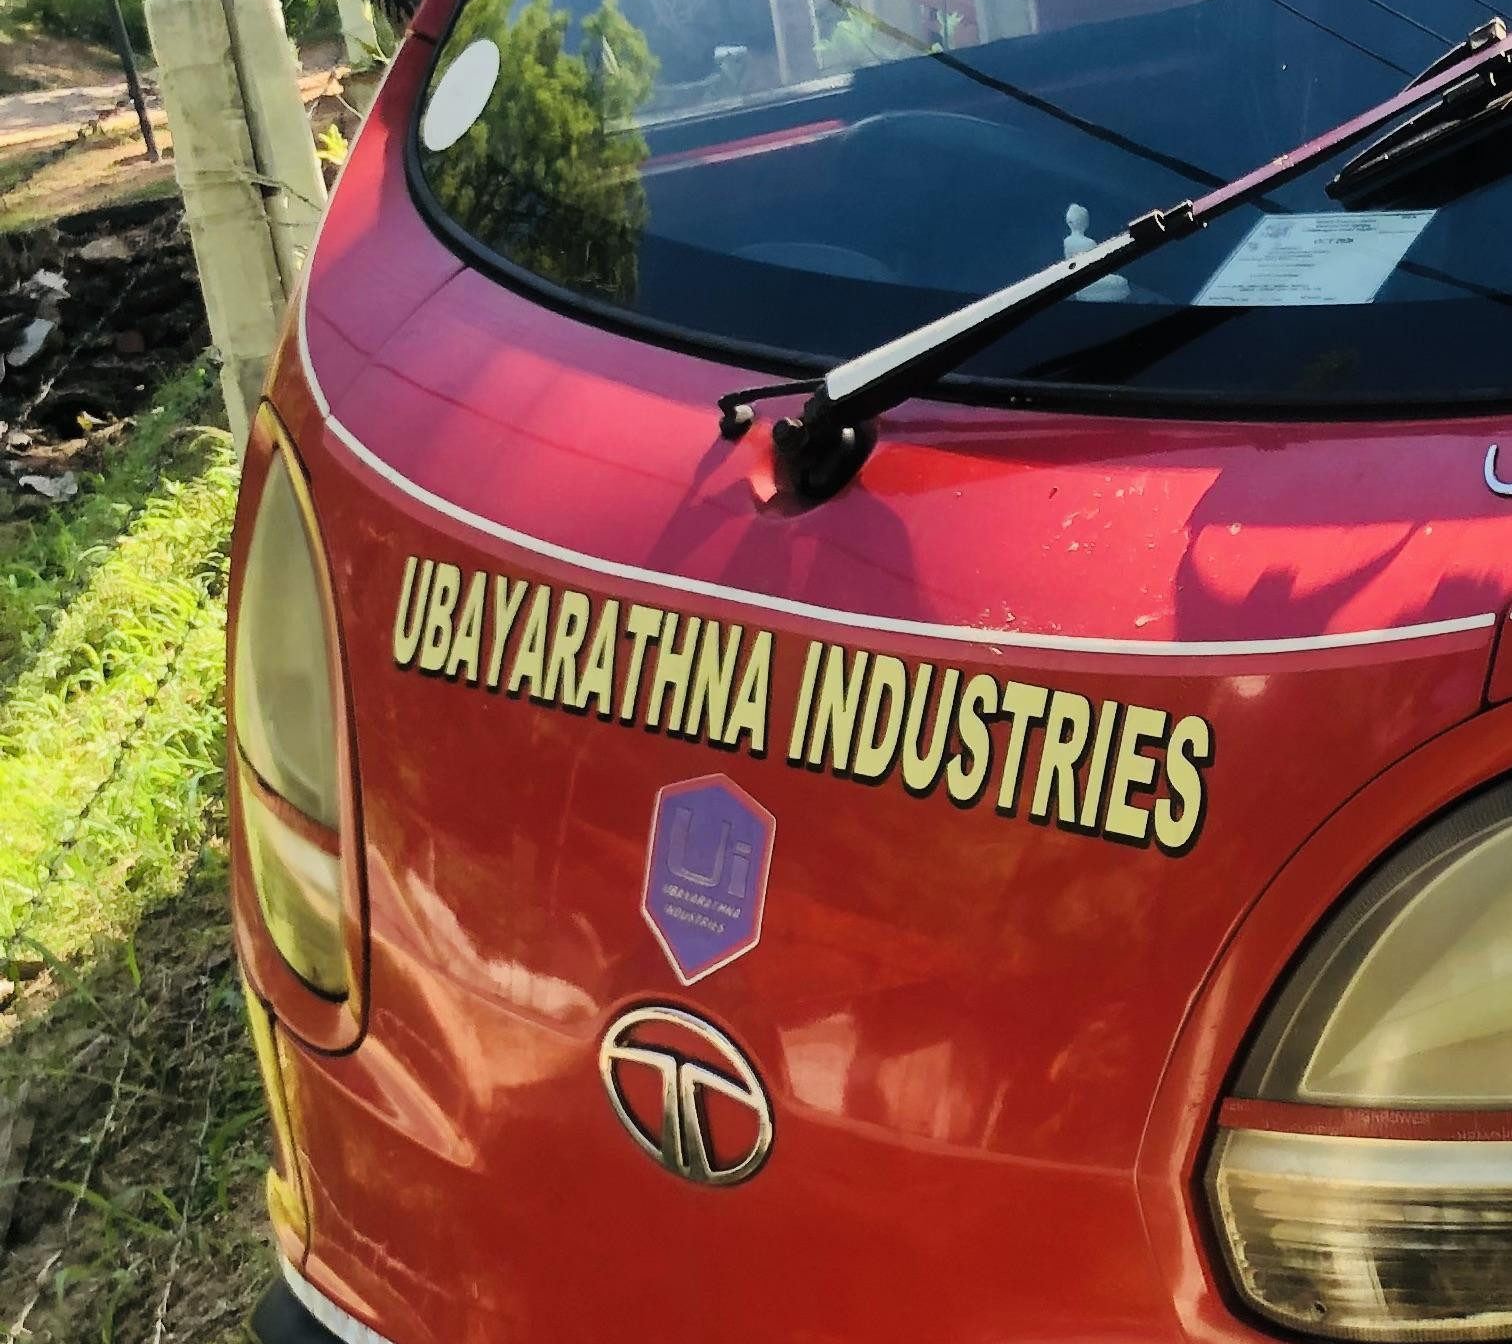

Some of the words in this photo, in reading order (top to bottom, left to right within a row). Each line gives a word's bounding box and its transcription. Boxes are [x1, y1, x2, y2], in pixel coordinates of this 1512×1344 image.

[393, 556, 775, 760] UBAYARATHNA
[788, 641, 1215, 857] INDUSTRIES
[663, 883, 741, 918] UBAYARATHNA
[664, 904, 725, 934] INDUSTRIES
